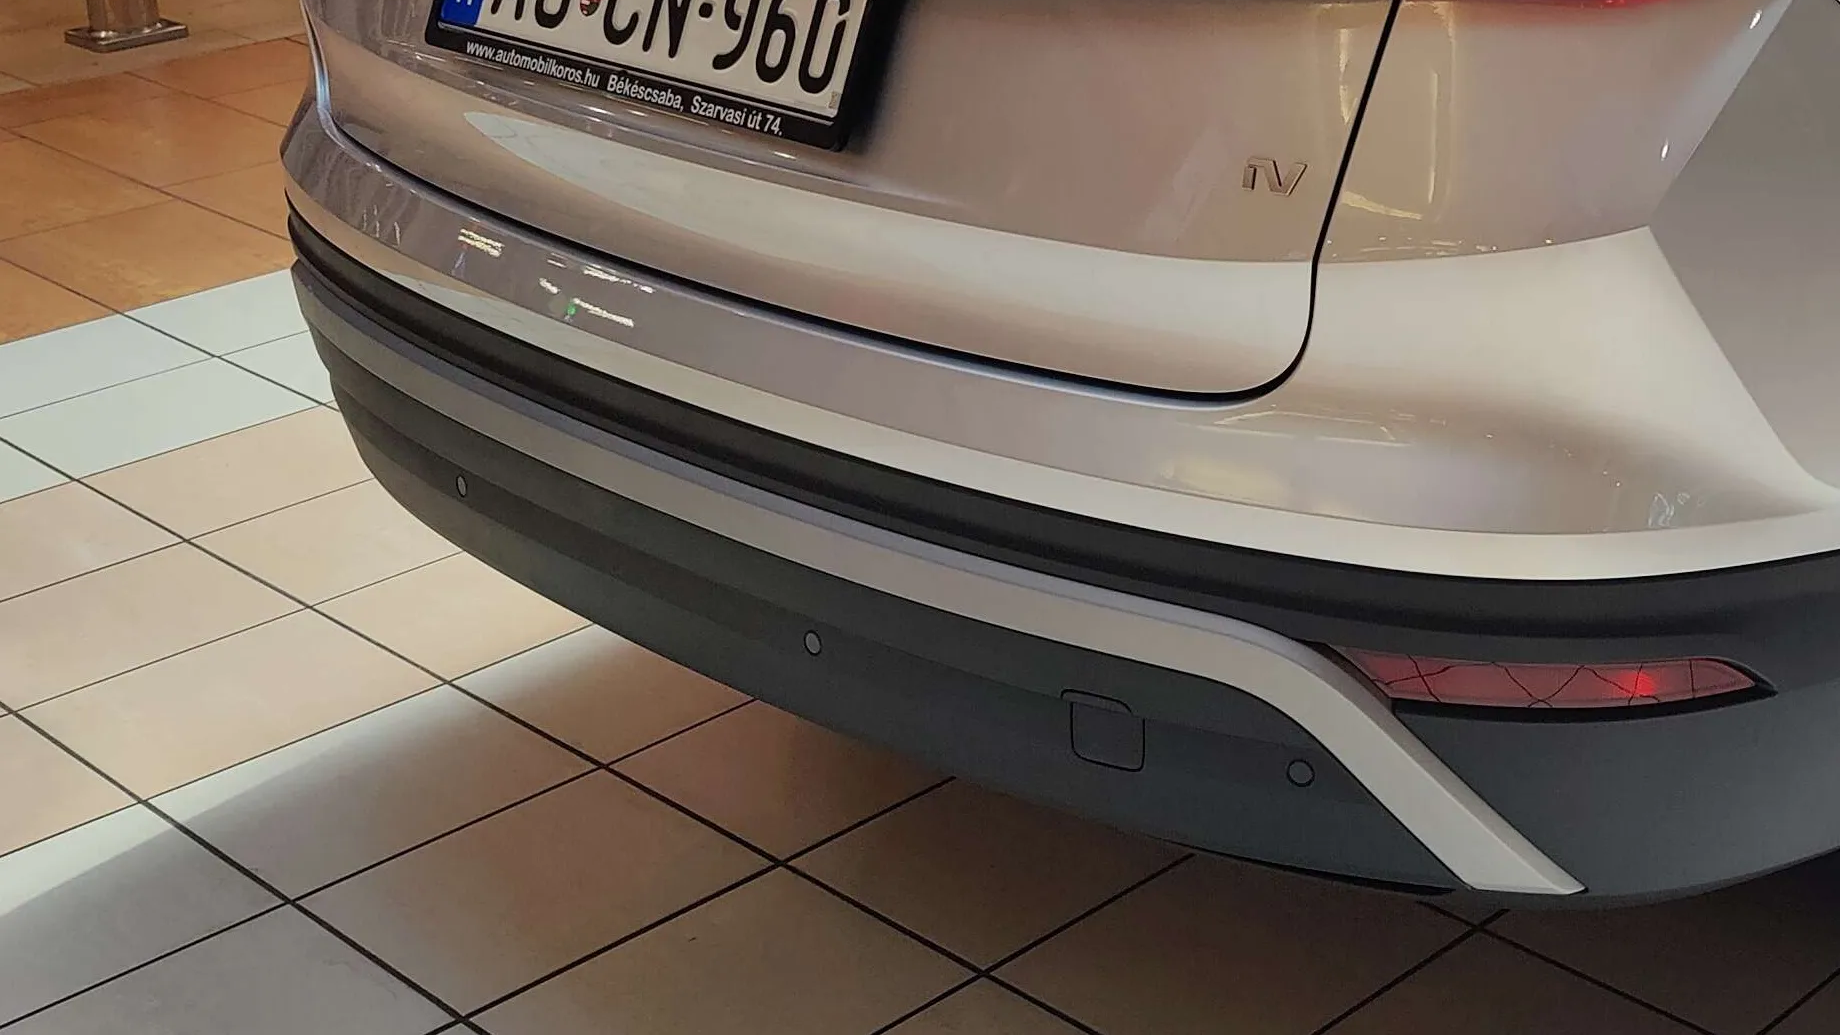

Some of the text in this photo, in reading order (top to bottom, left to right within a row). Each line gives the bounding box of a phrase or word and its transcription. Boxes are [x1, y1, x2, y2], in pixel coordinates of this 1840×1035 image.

[466, 40, 784, 137] www.automobilkoros.hu Békéscsaba, Szarvasi út 74.
